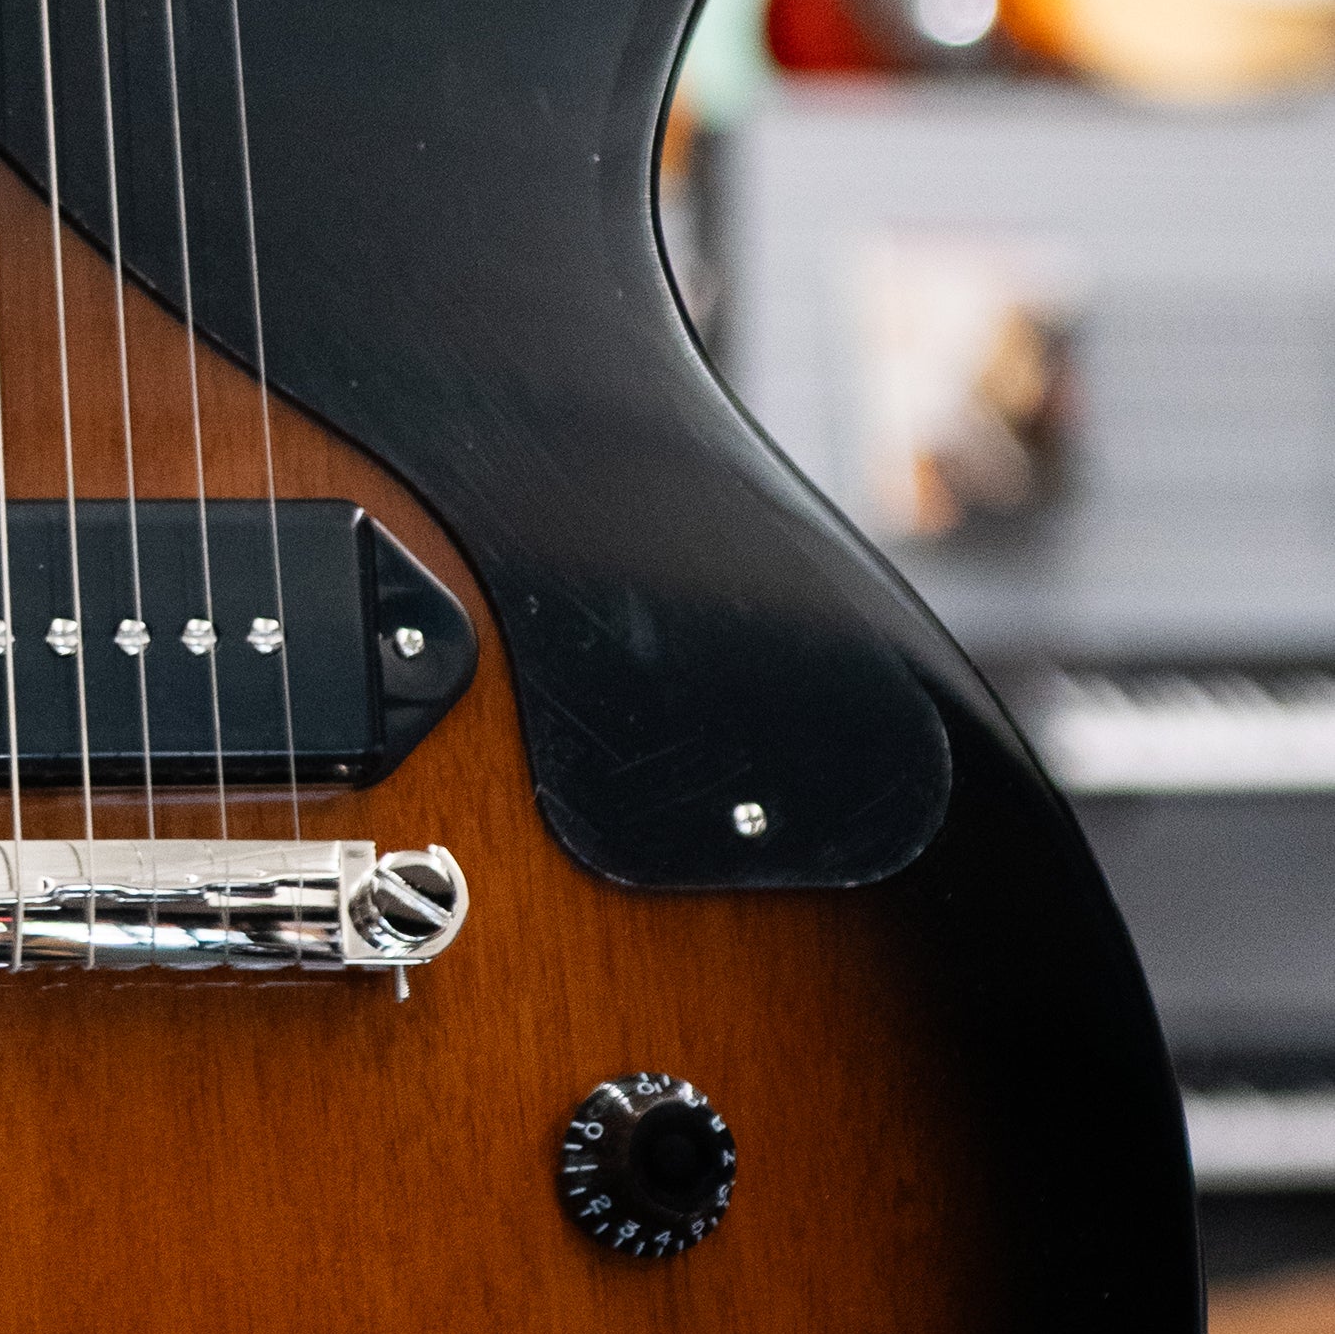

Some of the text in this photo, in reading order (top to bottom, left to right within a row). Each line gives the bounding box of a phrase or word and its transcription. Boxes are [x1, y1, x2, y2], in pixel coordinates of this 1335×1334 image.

[584, 1121, 604, 1141] 0
[590, 1194, 612, 1215] 2
[654, 1230, 672, 1246] 4
